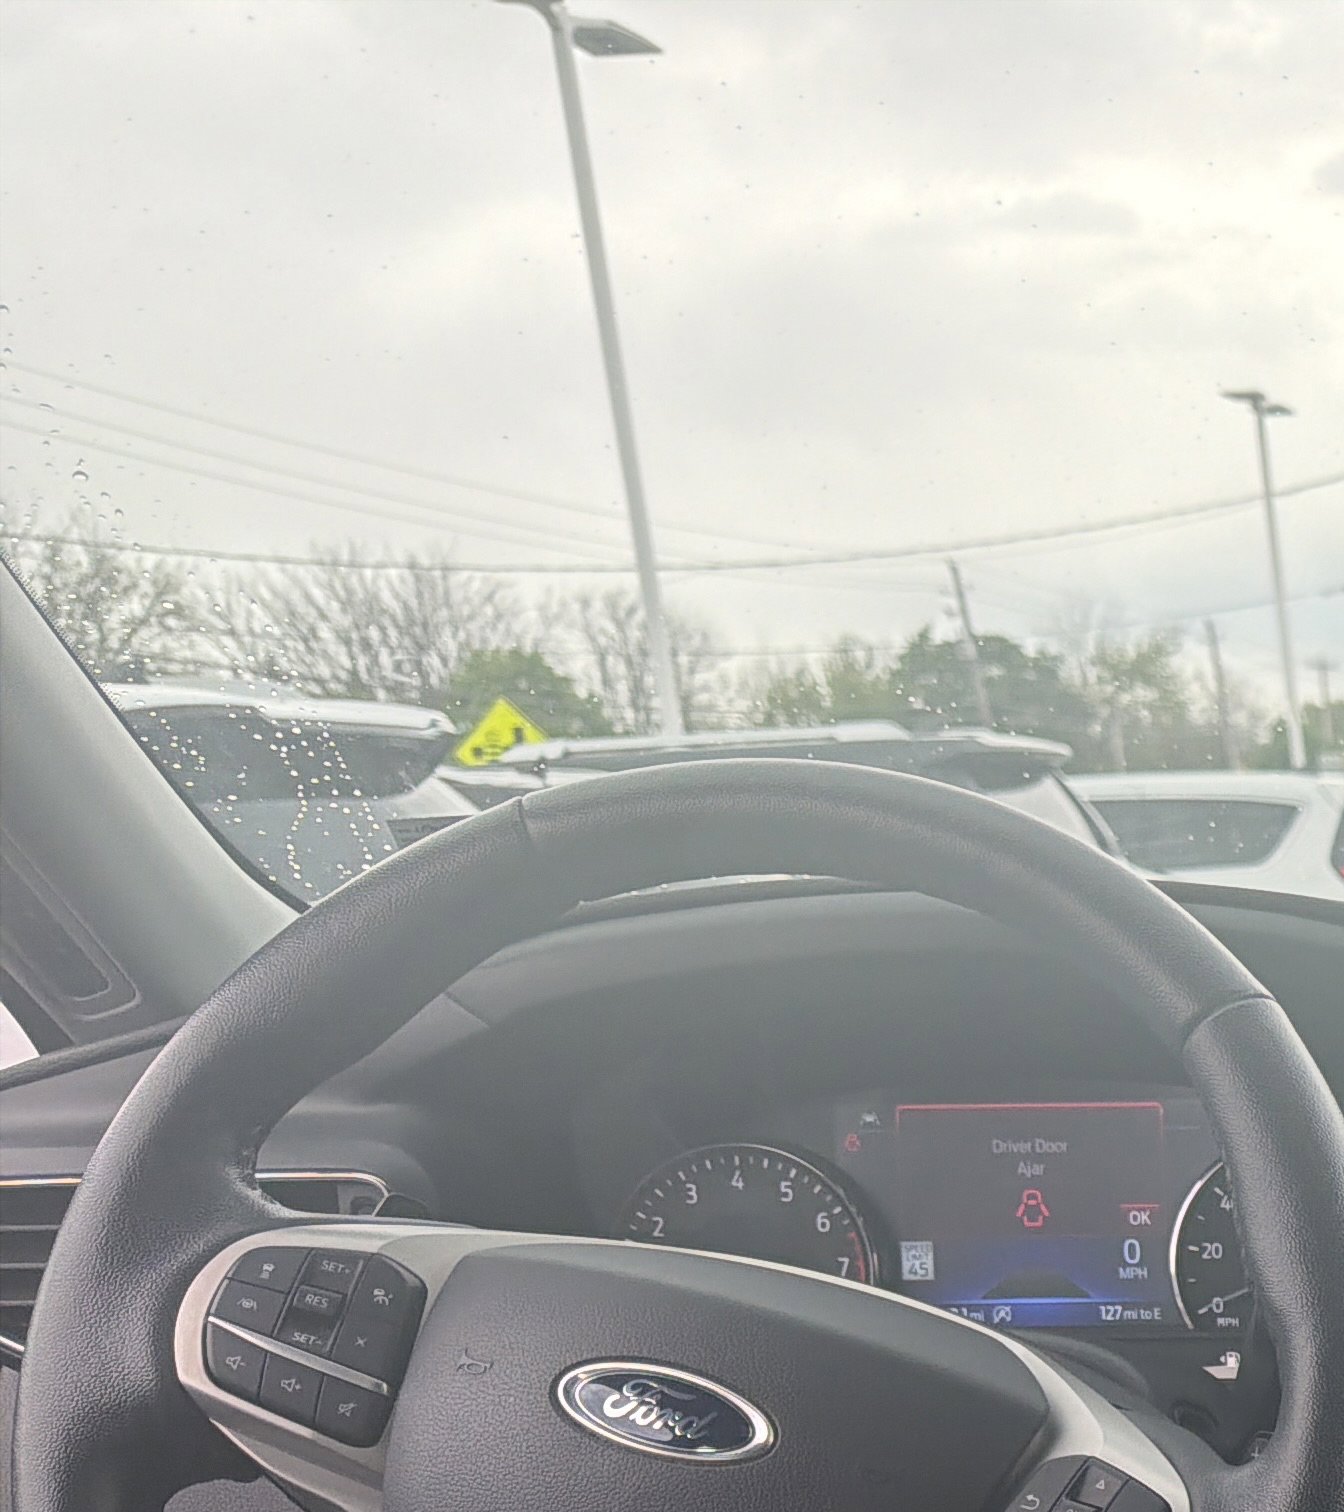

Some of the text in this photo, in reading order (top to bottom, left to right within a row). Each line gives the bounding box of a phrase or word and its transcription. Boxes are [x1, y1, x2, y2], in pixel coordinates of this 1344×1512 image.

[992, 1138, 1068, 1153] Driver Door
[1017, 1161, 1045, 1178] Ajar
[731, 1169, 744, 1190] 4
[685, 1183, 698, 1204] 3
[780, 1181, 793, 1202] 5
[1219, 1195, 1234, 1212] 4
[652, 1216, 665, 1237] 2
[816, 1211, 831, 1233] 6
[1129, 1211, 1151, 1225] OK
[1122, 1238, 1141, 1265] 0
[1201, 1242, 1223, 1260] 20
[837, 1256, 850, 1277] 7
[908, 1262, 929, 1278] 45
[1118, 1266, 1148, 1280] MPH
[304, 1294, 329, 1309] RES
[1211, 1297, 1224, 1314] 0
[1099, 1305, 1162, 1321] 127 mi to E
[1216, 1317, 1240, 1328] MPH
[602, 1379, 719, 1440] Ford
